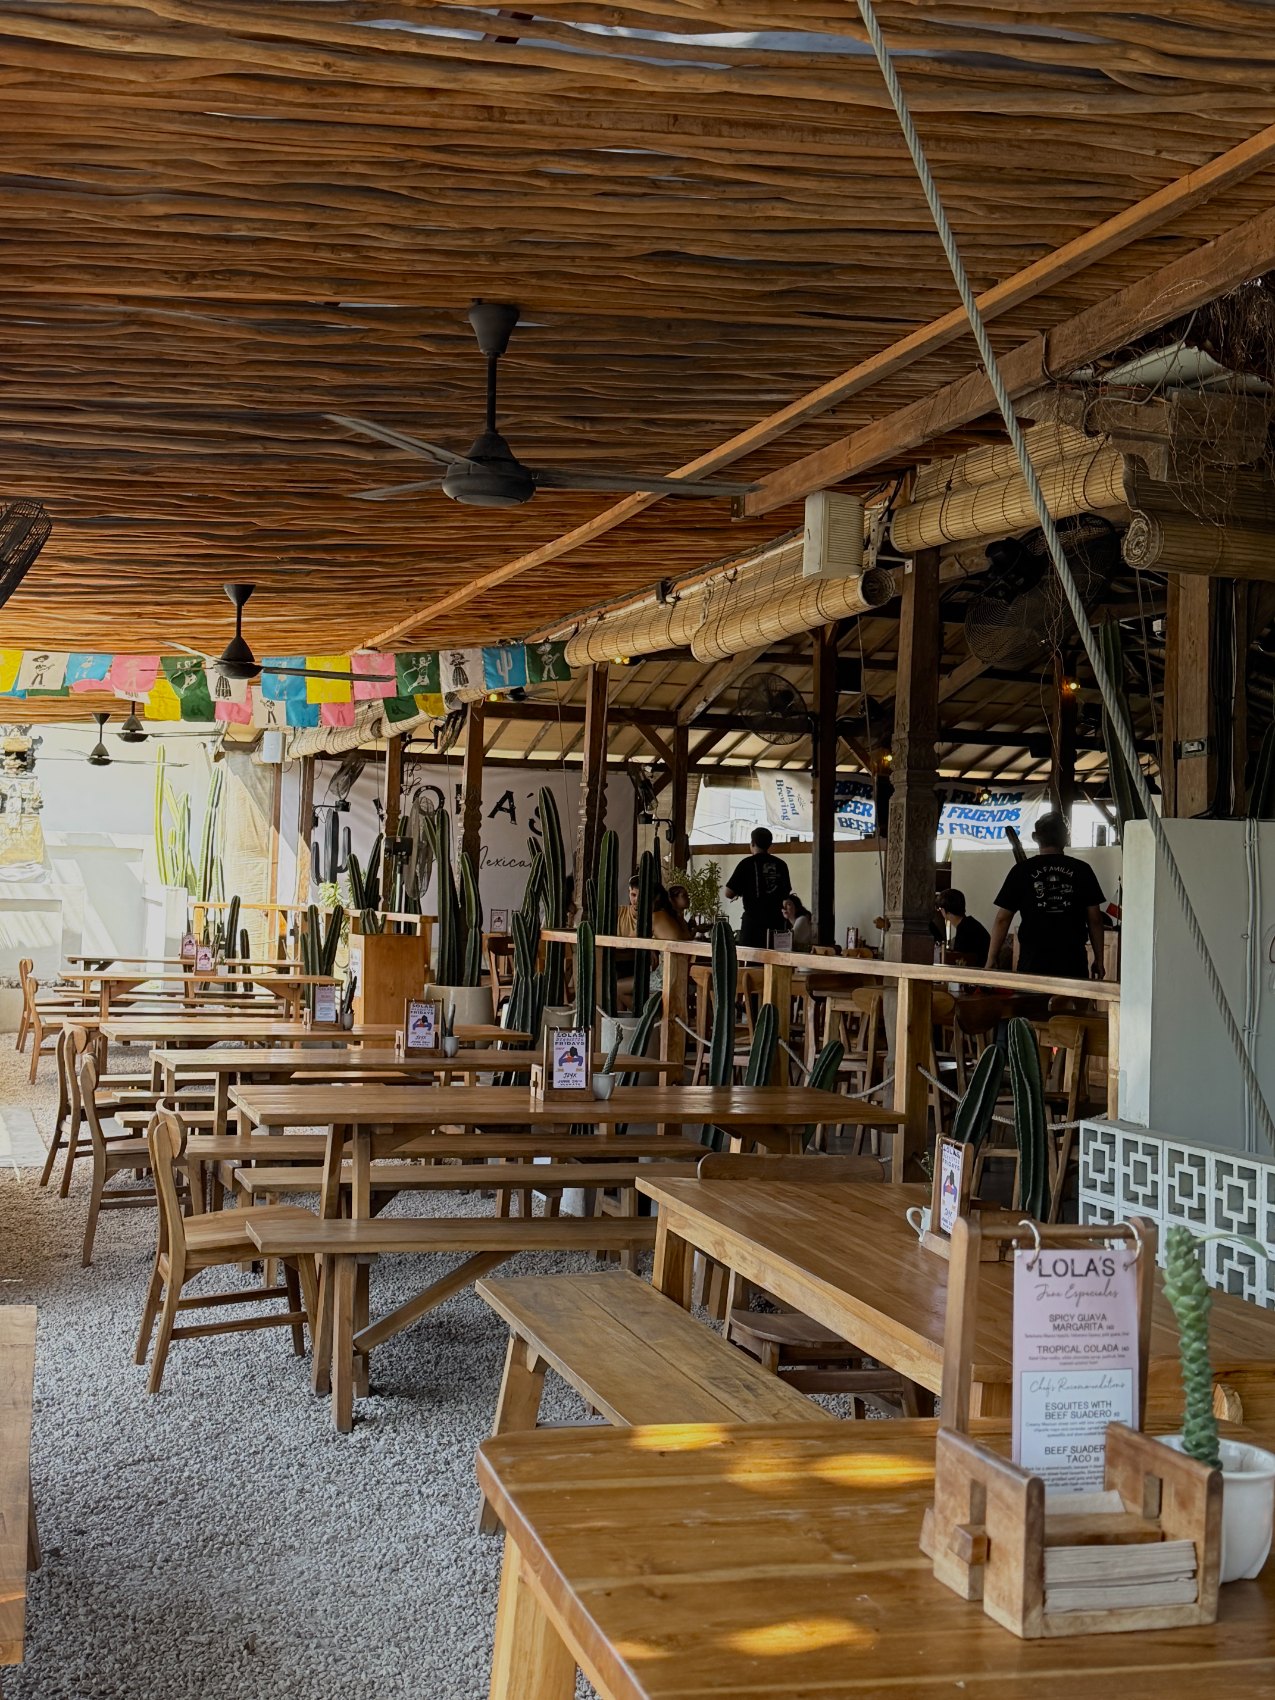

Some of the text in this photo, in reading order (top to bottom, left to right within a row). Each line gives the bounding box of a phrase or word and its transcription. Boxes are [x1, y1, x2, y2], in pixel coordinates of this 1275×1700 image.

[775, 779, 791, 821] Brewing
[785, 785, 800, 816] Island
[946, 806, 1022, 823] FRIENDS
[1038, 1256, 1116, 1278] LOLA'S
[1034, 1283, 1063, 1301] June
[1048, 1313, 1107, 1323] SPICY GUAVA
[1052, 1322, 1104, 1332] MARGARITA
[1036, 1345, 1081, 1355] TROPICAL
[1083, 1343, 1119, 1353] COLADA
[1045, 1400, 1112, 1411] ESQUITES WITH
[1044, 1411, 1069, 1421] BEEF
[1070, 1409, 1112, 1420] SUADERO
[1044, 1444, 1106, 1456] BEEF SUADER
[1065, 1454, 1092, 1464] TACO
